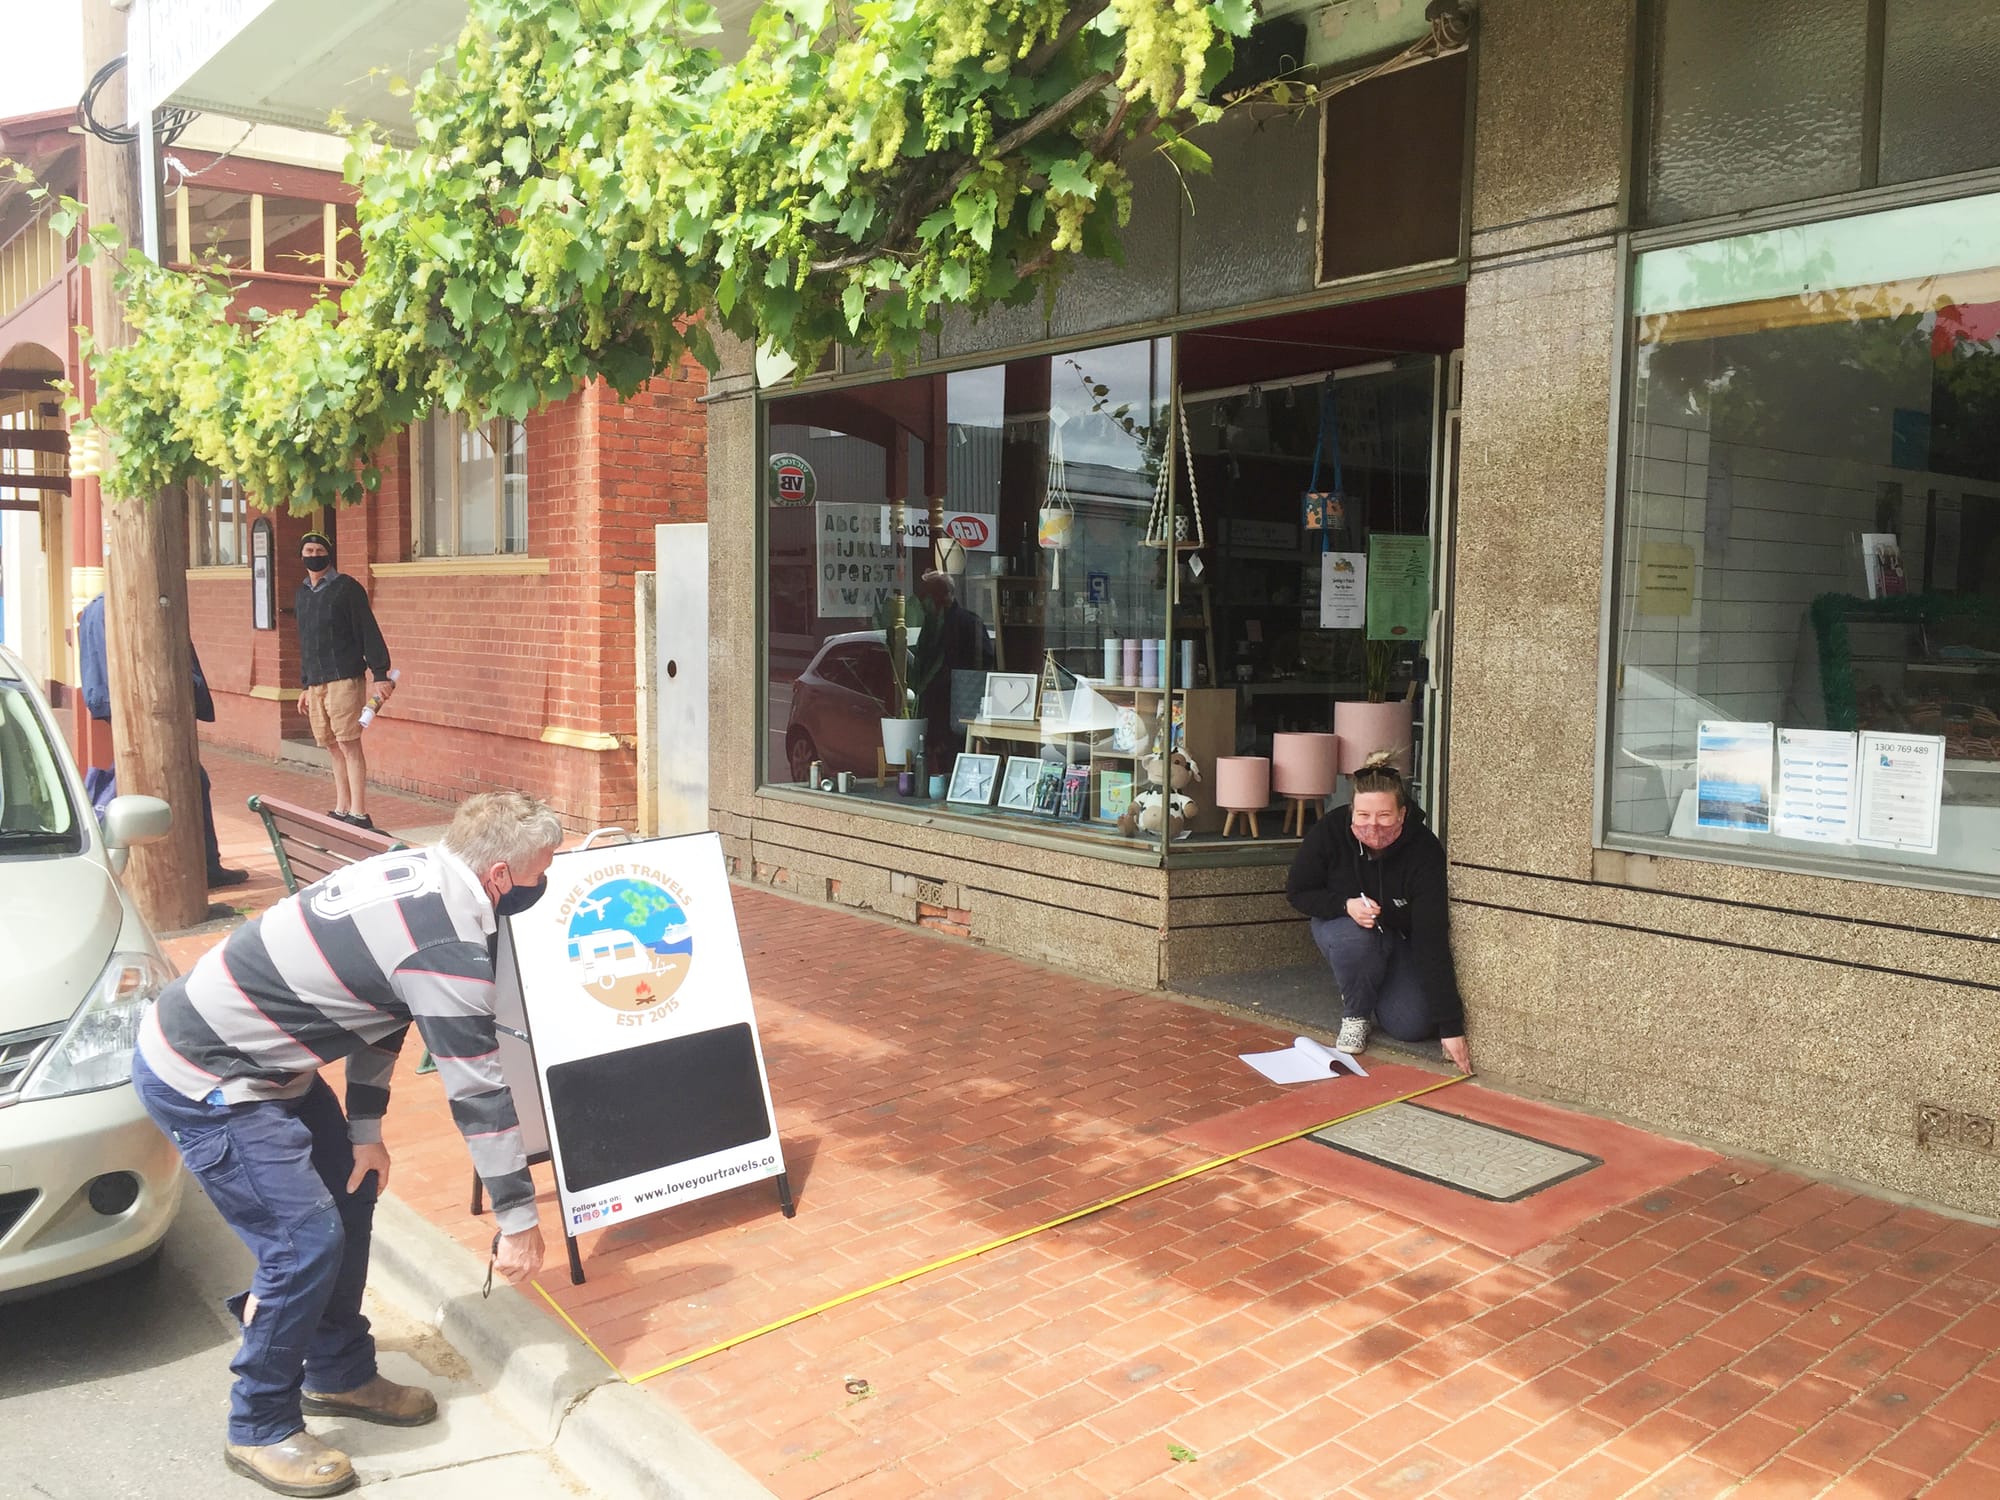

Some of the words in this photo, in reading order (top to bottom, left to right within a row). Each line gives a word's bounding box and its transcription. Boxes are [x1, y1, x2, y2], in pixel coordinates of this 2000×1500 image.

[1874, 743, 1895, 751] 1300
[1896, 744, 1912, 753] 769
[1913, 746, 1929, 754] 489
[555, 885, 585, 925] LOVE
[584, 864, 626, 887] YOUR
[631, 863, 693, 907] TRAVELS
[616, 1013, 645, 1027] EST
[650, 997, 681, 1023] 2015
[633, 1155, 776, 1203] www.loveyourtravels.co
[571, 1202, 597, 1214] Follow
[598, 1198, 608, 1206] us
